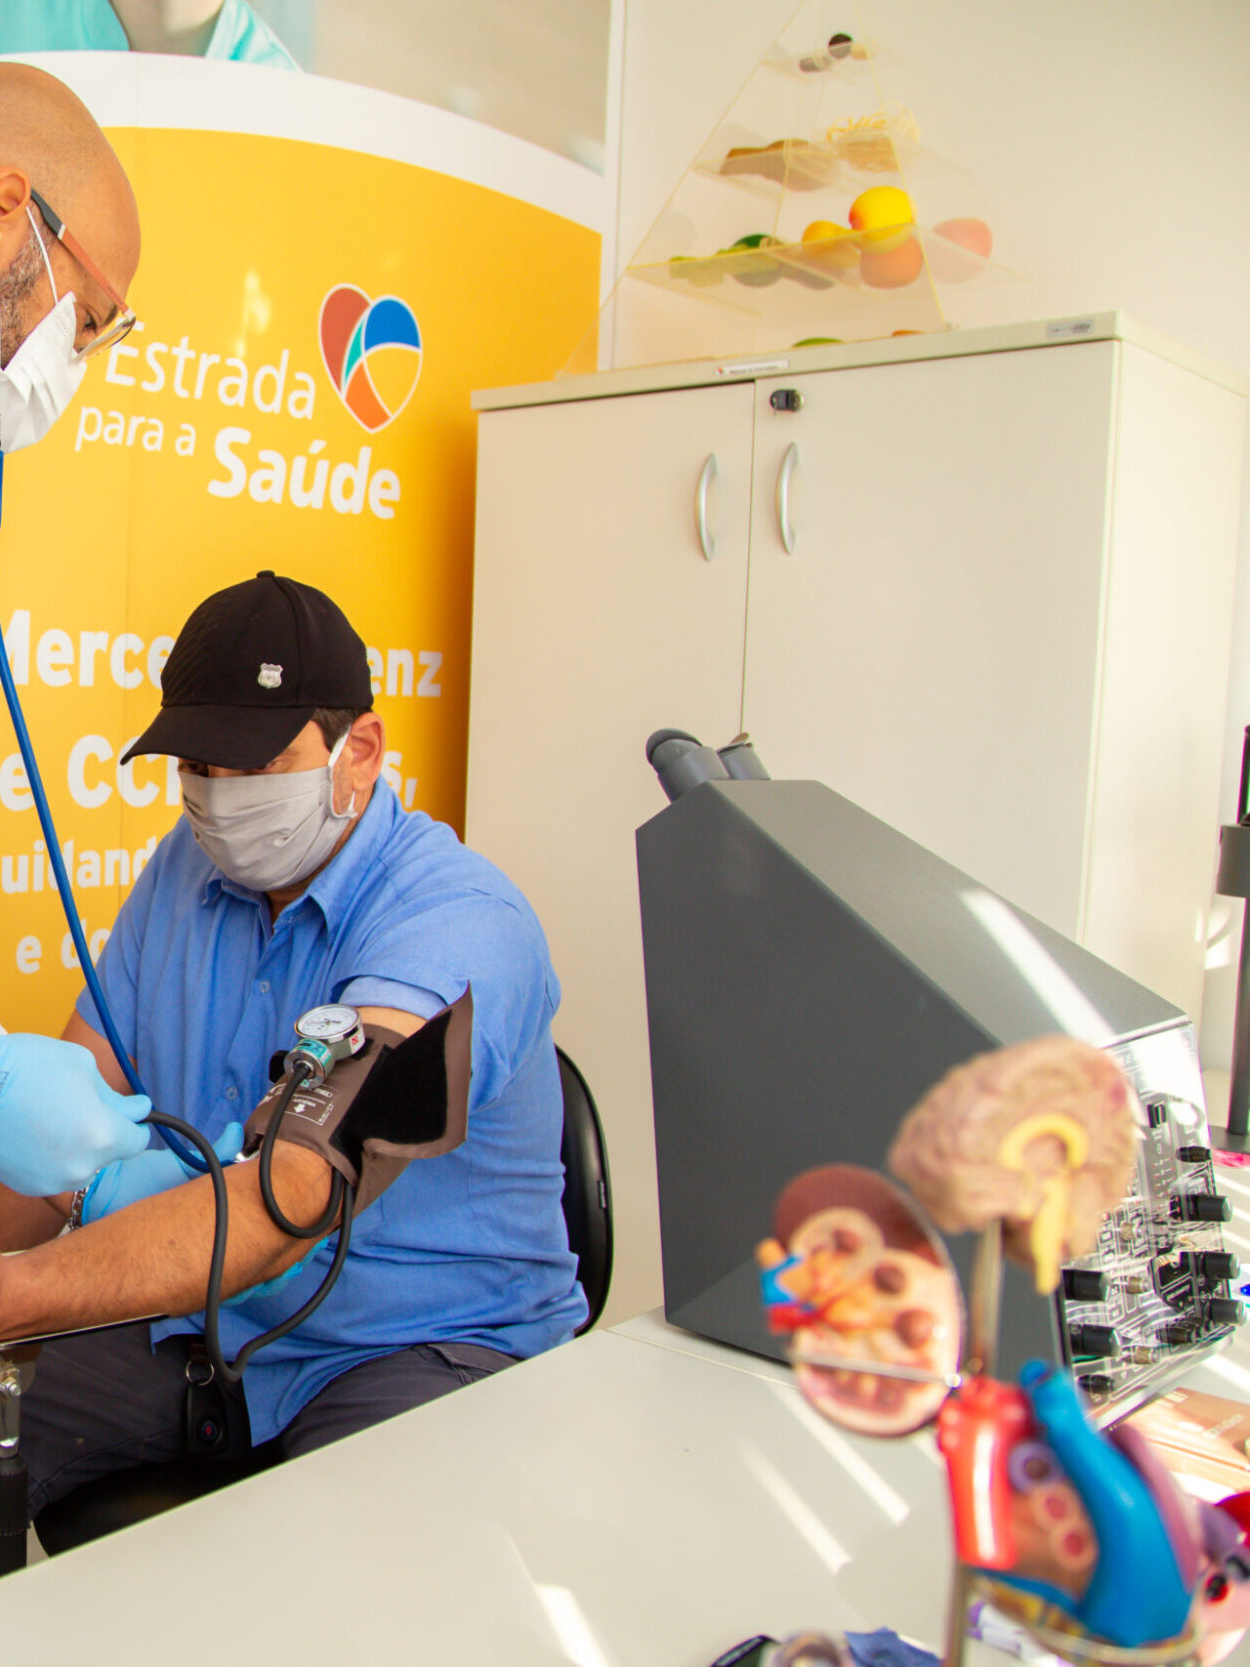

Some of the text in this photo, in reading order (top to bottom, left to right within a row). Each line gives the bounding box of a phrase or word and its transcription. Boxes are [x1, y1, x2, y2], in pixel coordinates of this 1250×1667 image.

[105, 317, 316, 420] Estrada
[75, 406, 401, 519] para a Saúde
[16, 935, 42, 974] e
